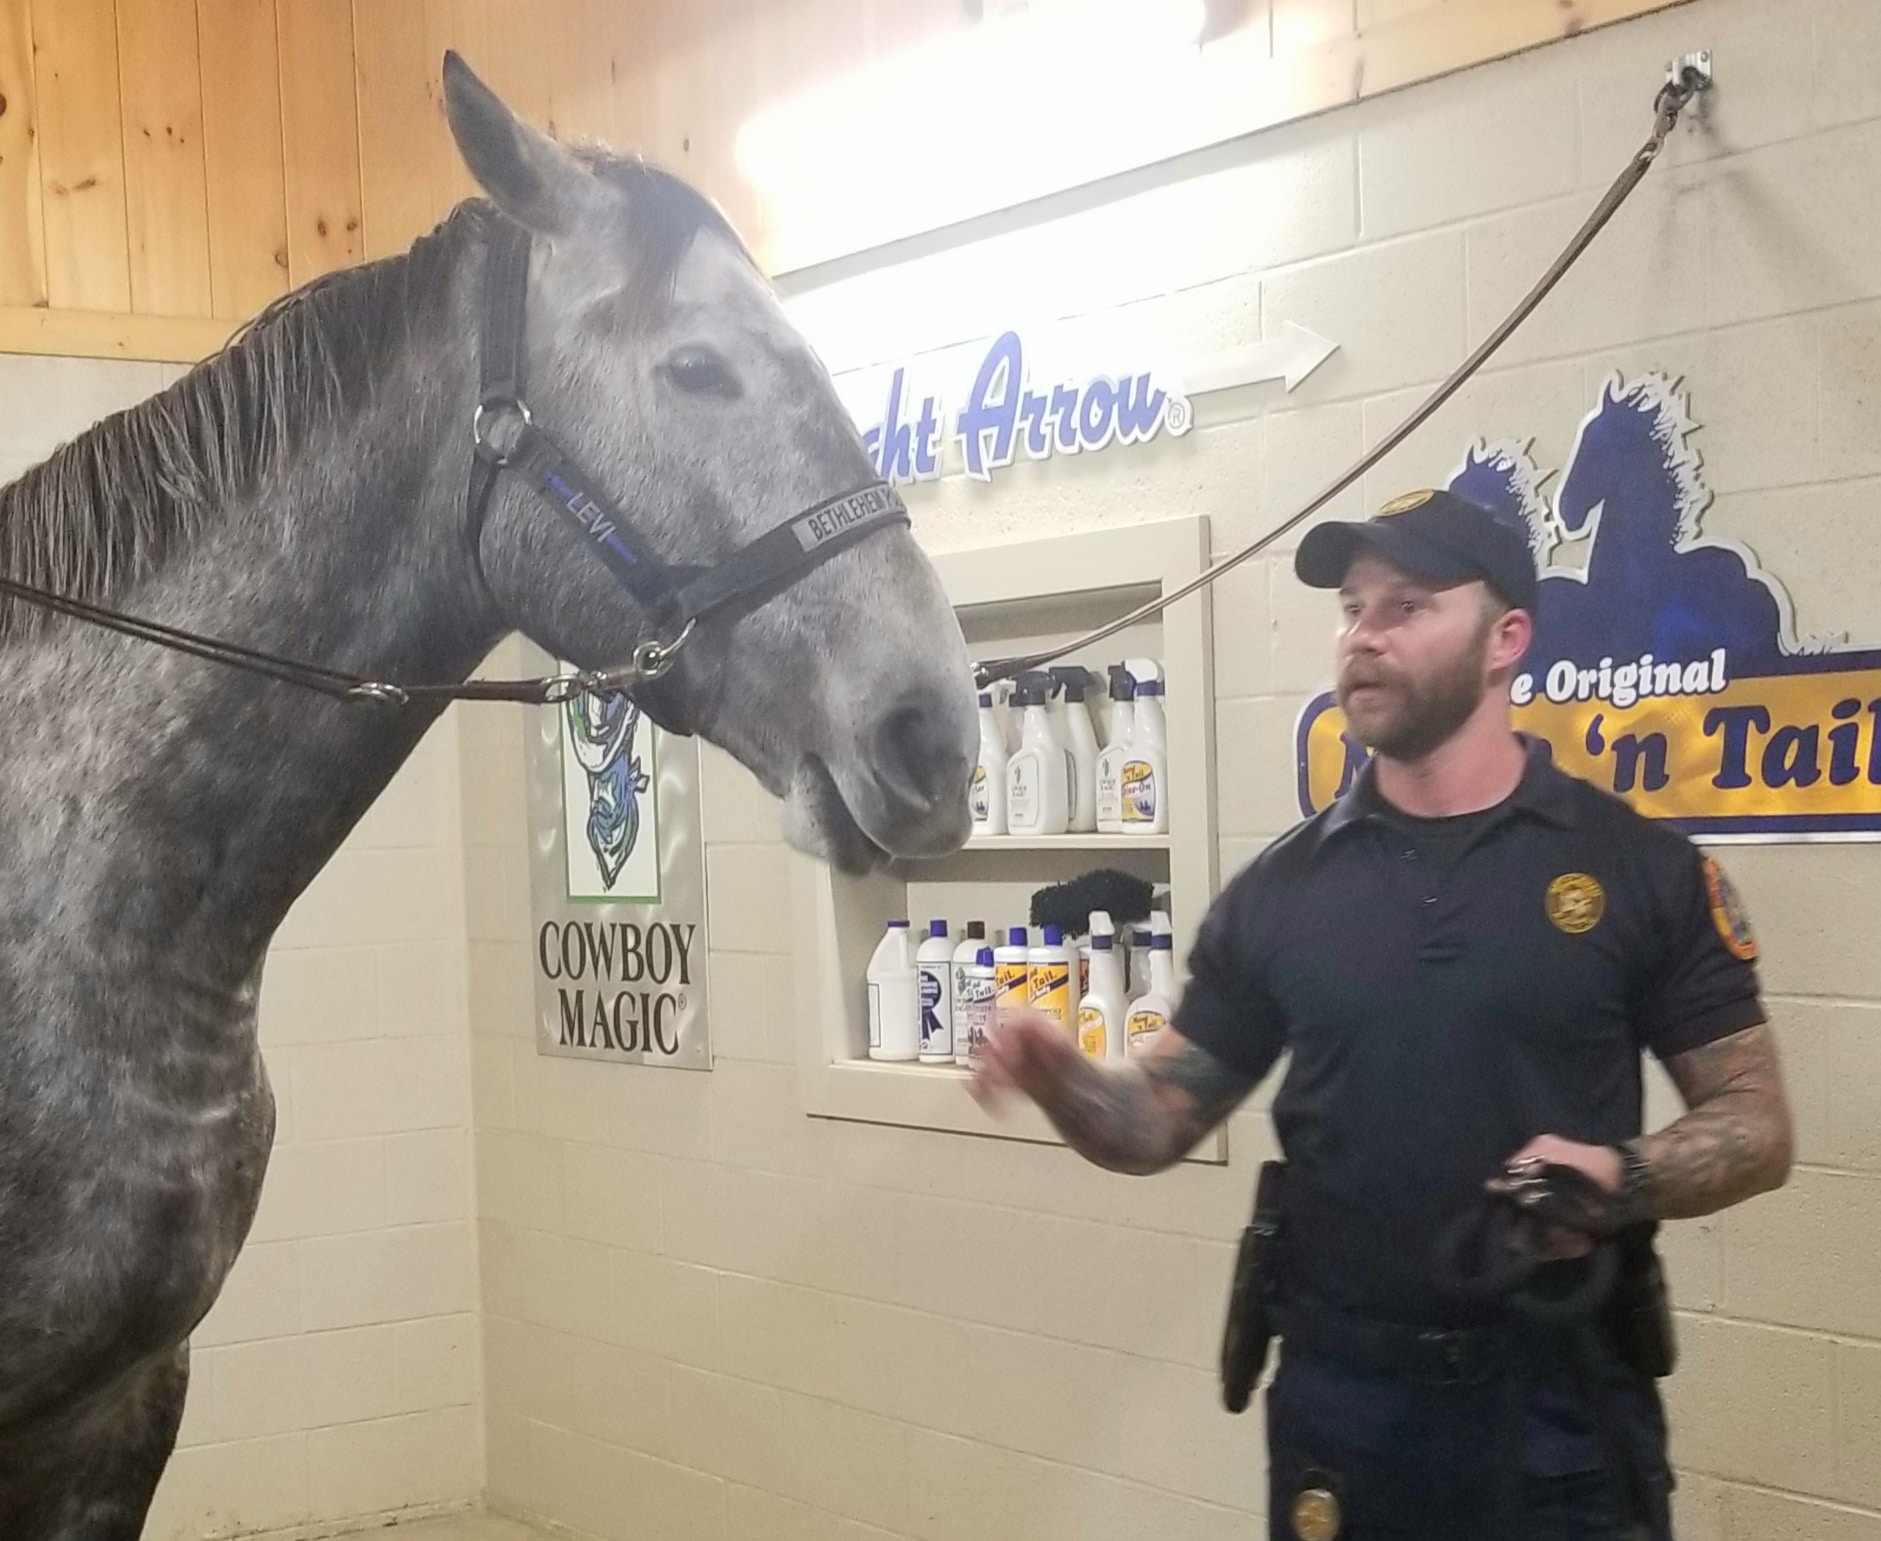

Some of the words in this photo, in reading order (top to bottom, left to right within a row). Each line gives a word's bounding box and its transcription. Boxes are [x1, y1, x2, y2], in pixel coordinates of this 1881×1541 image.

[566, 491, 617, 543] LEVI
[1545, 648, 1727, 707] Original
[538, 920, 697, 986] COWBOY
